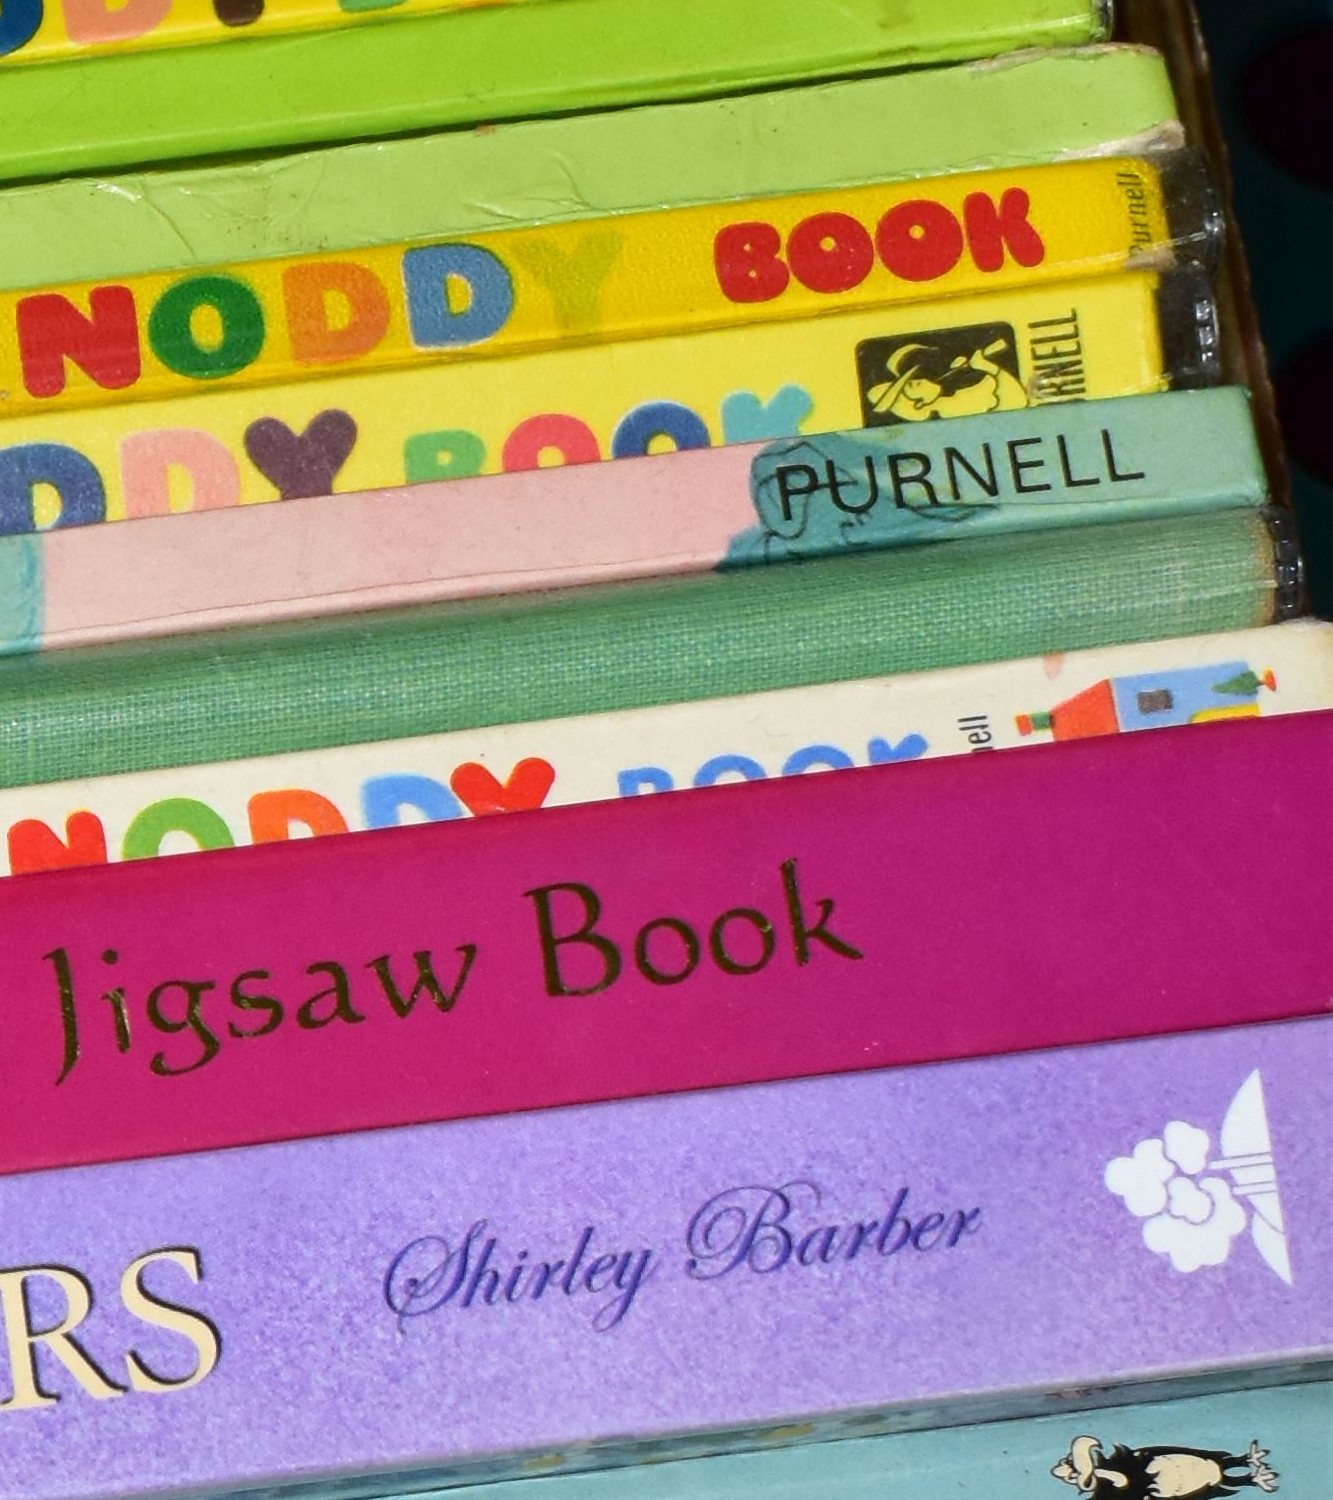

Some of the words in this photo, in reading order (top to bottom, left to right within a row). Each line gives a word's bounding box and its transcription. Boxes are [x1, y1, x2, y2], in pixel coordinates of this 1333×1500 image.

[15, 231, 622, 398] NODDY
[712, 188, 1044, 303] BOOK
[775, 430, 1146, 521] PURNELL
[47, 939, 478, 1088] Jigsaw
[524, 857, 864, 1003] Book
[383, 1219, 658, 1333] Shirley
[684, 1179, 983, 1282] Barber
